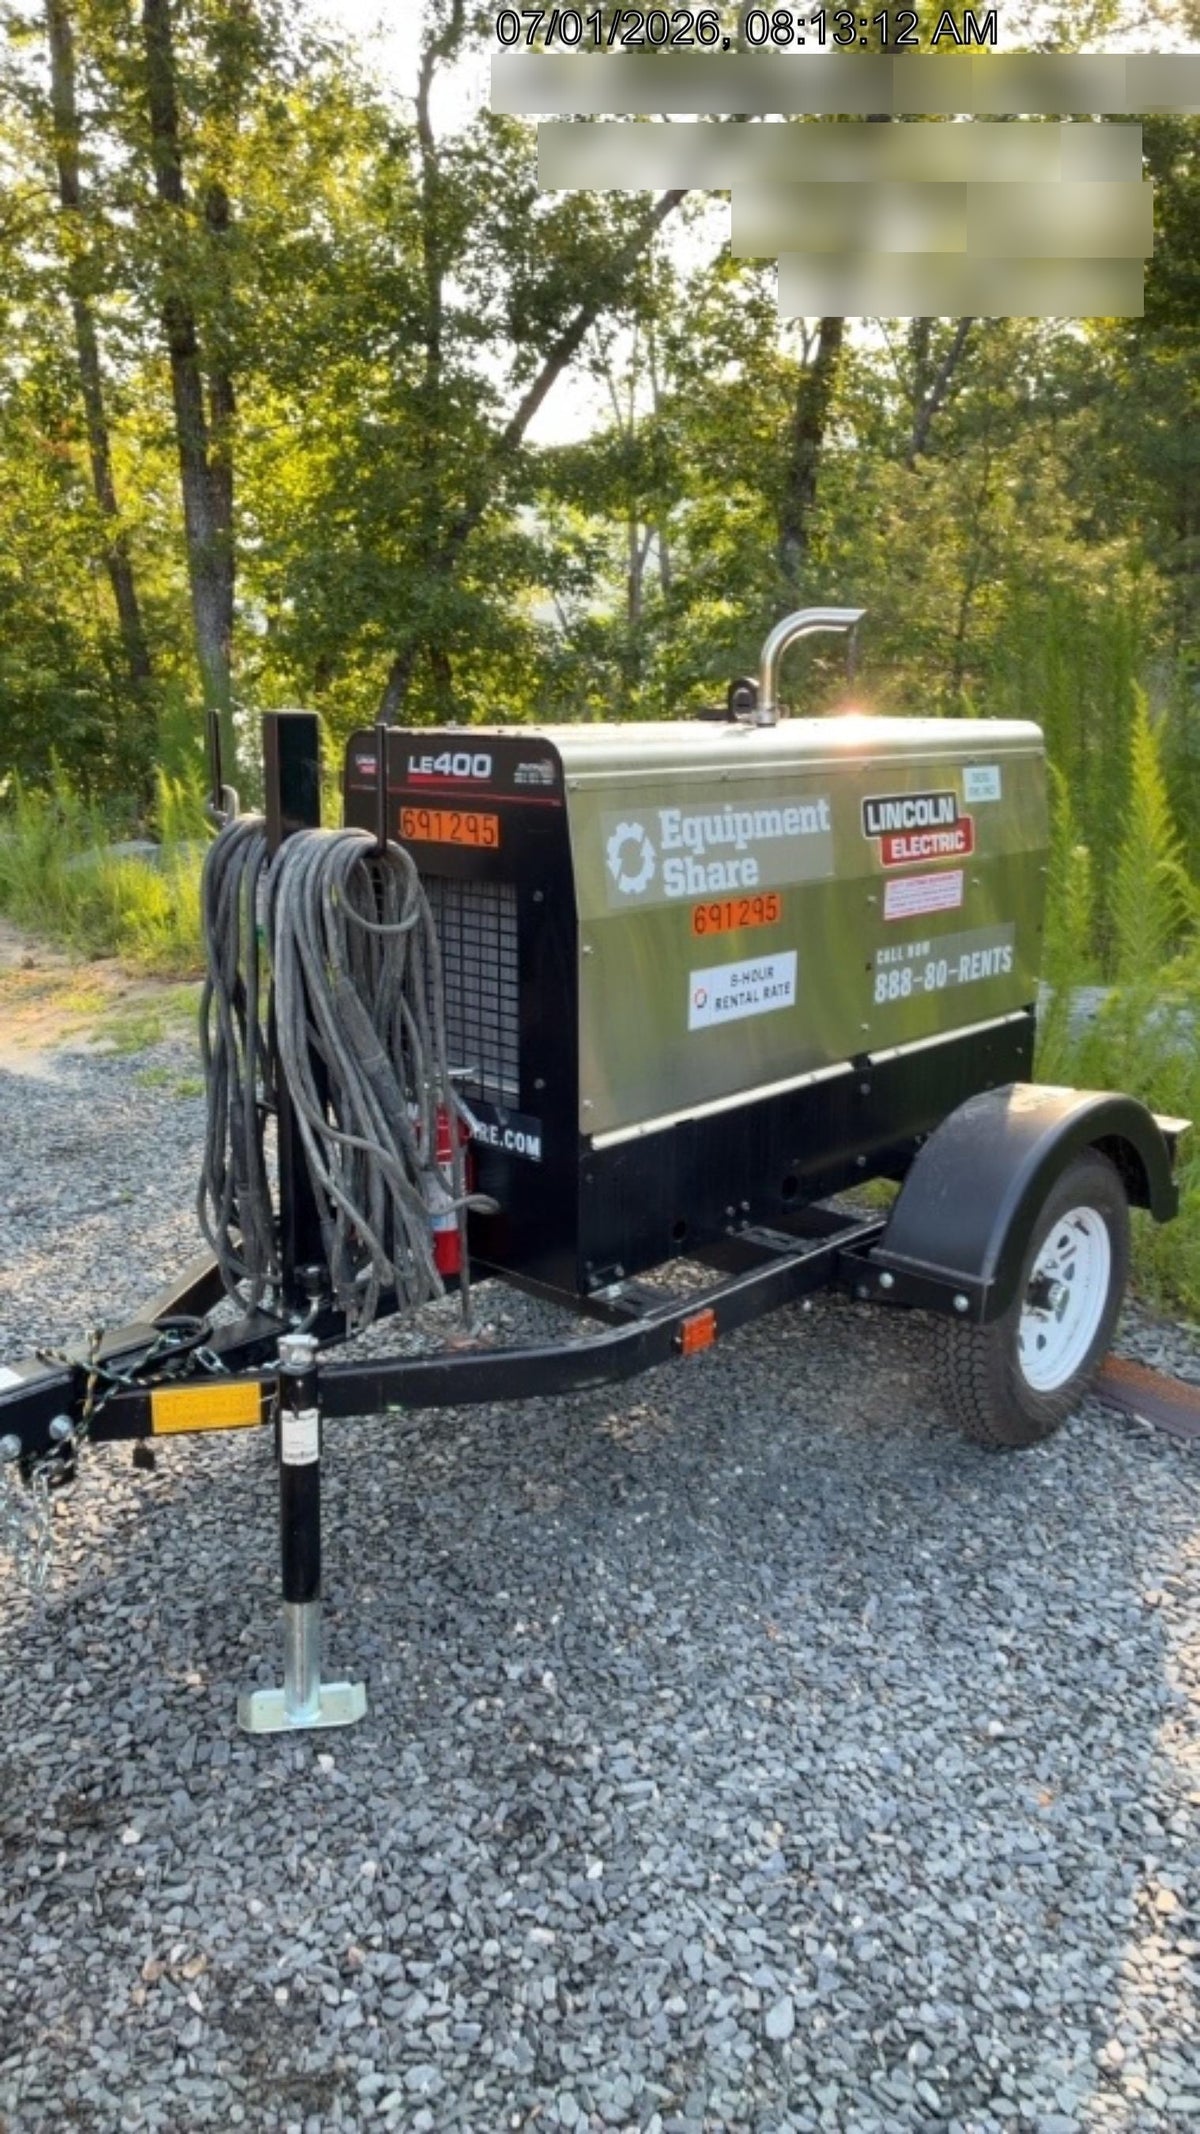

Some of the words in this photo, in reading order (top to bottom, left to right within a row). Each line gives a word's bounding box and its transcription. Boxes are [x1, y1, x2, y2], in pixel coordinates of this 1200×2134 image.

[408, 753, 492, 777] LE400
[403, 810, 495, 845] 691295
[658, 798, 831, 854] Equipment
[867, 796, 954, 832] LINCOLN
[891, 830, 966, 859] ELECTRIC
[663, 857, 759, 897] Share
[694, 895, 777, 934] 691295
[876, 946, 903, 965] CALL
[874, 945, 1013, 1004] 888-80-RENTS
[715, 990, 759, 1011] RENTAL
[763, 981, 791, 999] RATE
